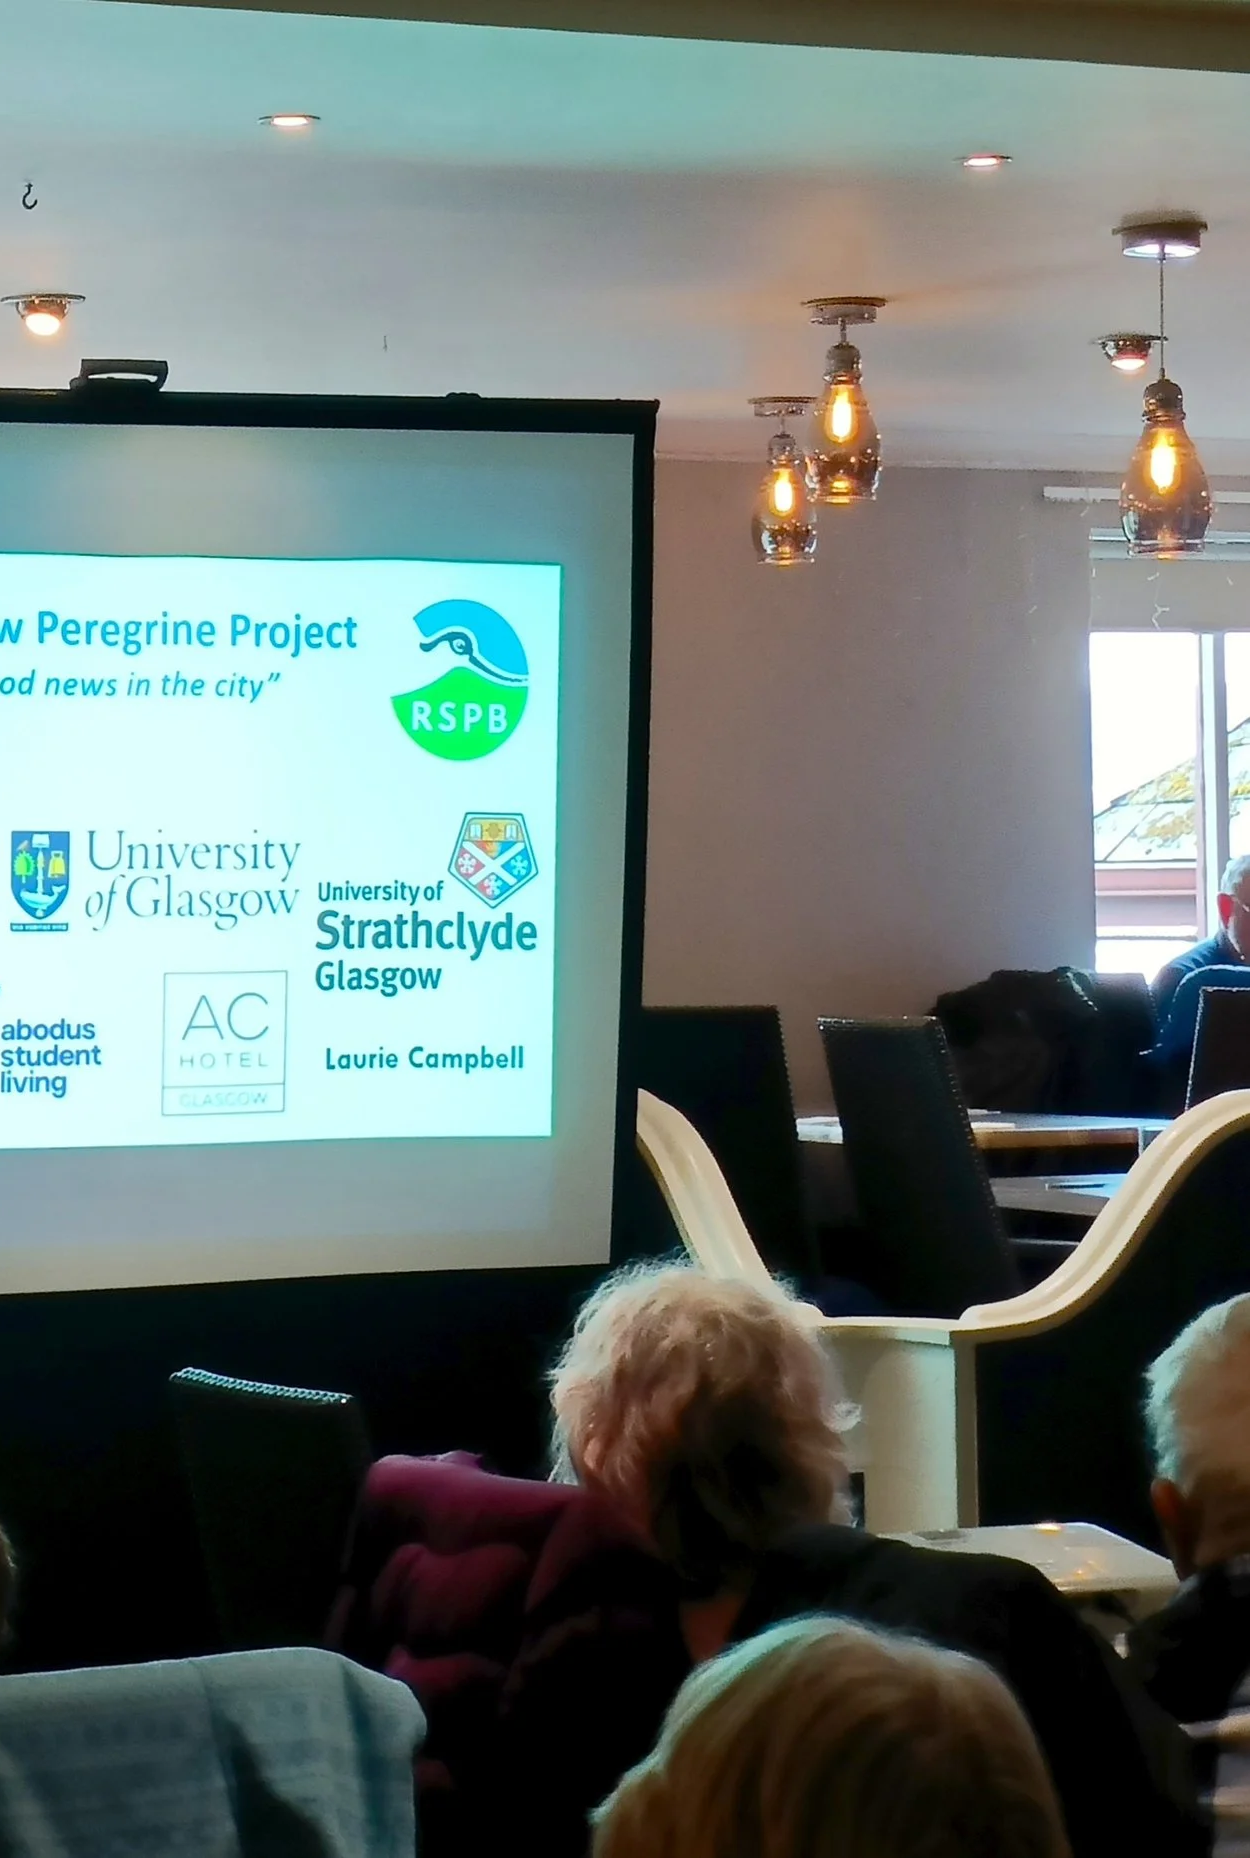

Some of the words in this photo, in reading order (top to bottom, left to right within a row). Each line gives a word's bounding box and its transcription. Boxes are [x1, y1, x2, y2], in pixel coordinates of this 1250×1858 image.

[37, 610, 217, 657] Peregrine
[230, 612, 359, 659] Project
[44, 676, 118, 697] news
[126, 671, 151, 697] in
[161, 670, 206, 697] the
[410, 699, 509, 734] RSPB
[87, 829, 301, 882] University
[84, 873, 126, 932] of
[125, 875, 301, 931] Glasgow
[317, 879, 419, 907] University
[423, 879, 445, 902] of
[315, 910, 538, 961] Strathclyde
[315, 959, 443, 998] Glasgow
[0, 1018, 96, 1042] abodus
[181, 991, 270, 1042] AC
[0, 1044, 102, 1067] student
[179, 1051, 269, 1070] HOTEL
[325, 1046, 399, 1071] Laurie
[408, 1045, 525, 1075] Campbell
[0, 1069, 67, 1099] living
